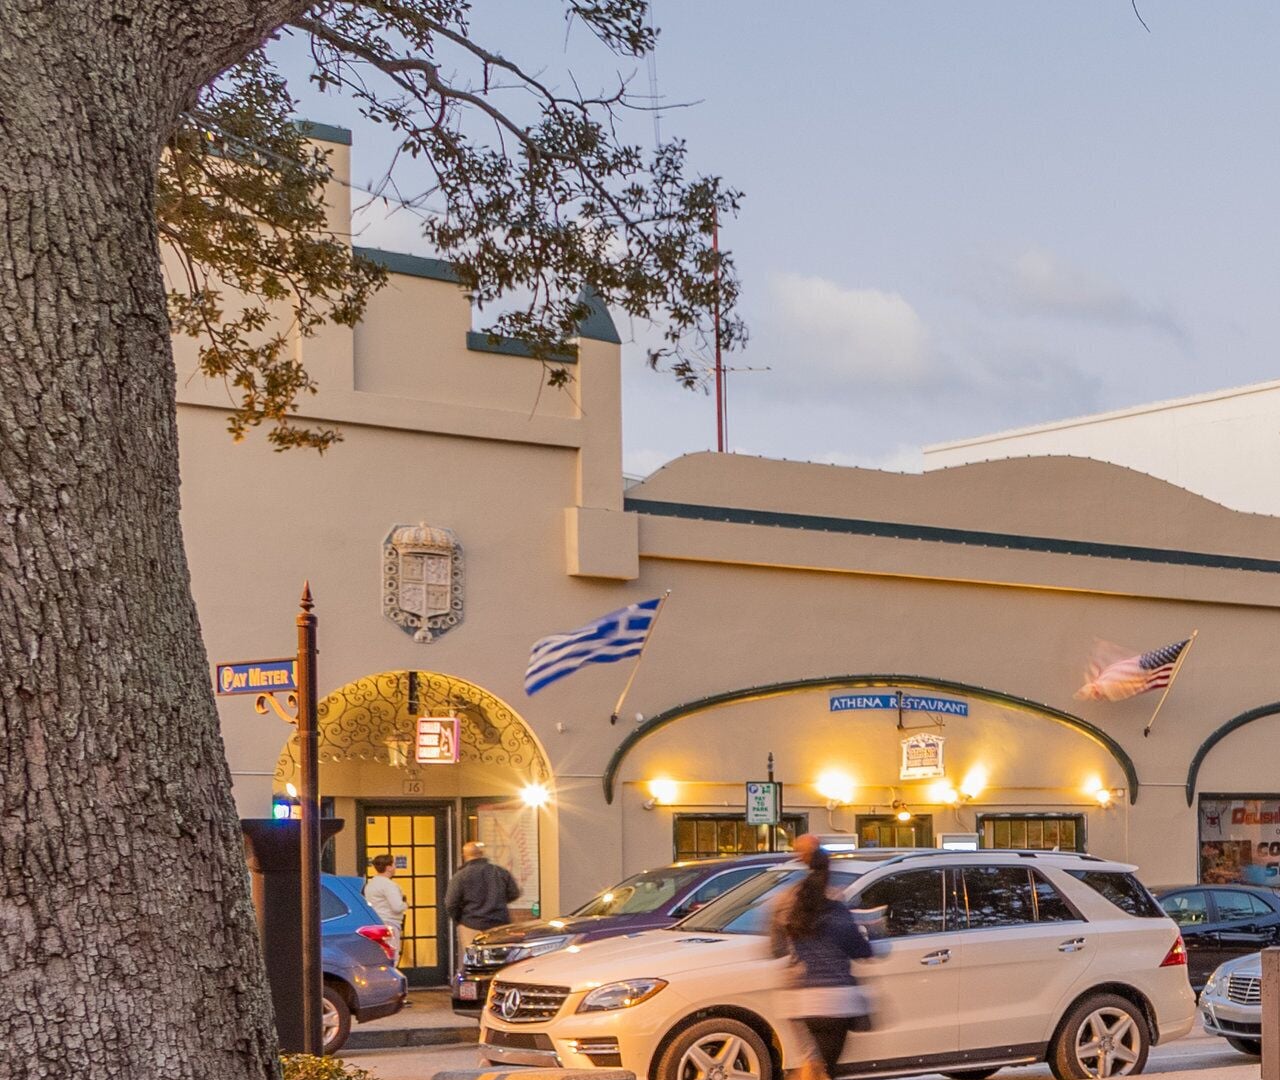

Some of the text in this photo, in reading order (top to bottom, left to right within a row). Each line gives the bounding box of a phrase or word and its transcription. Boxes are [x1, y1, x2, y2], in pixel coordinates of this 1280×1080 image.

[832, 697, 967, 714] ATHENA RESTAURANT
[409, 782, 420, 793] 16
